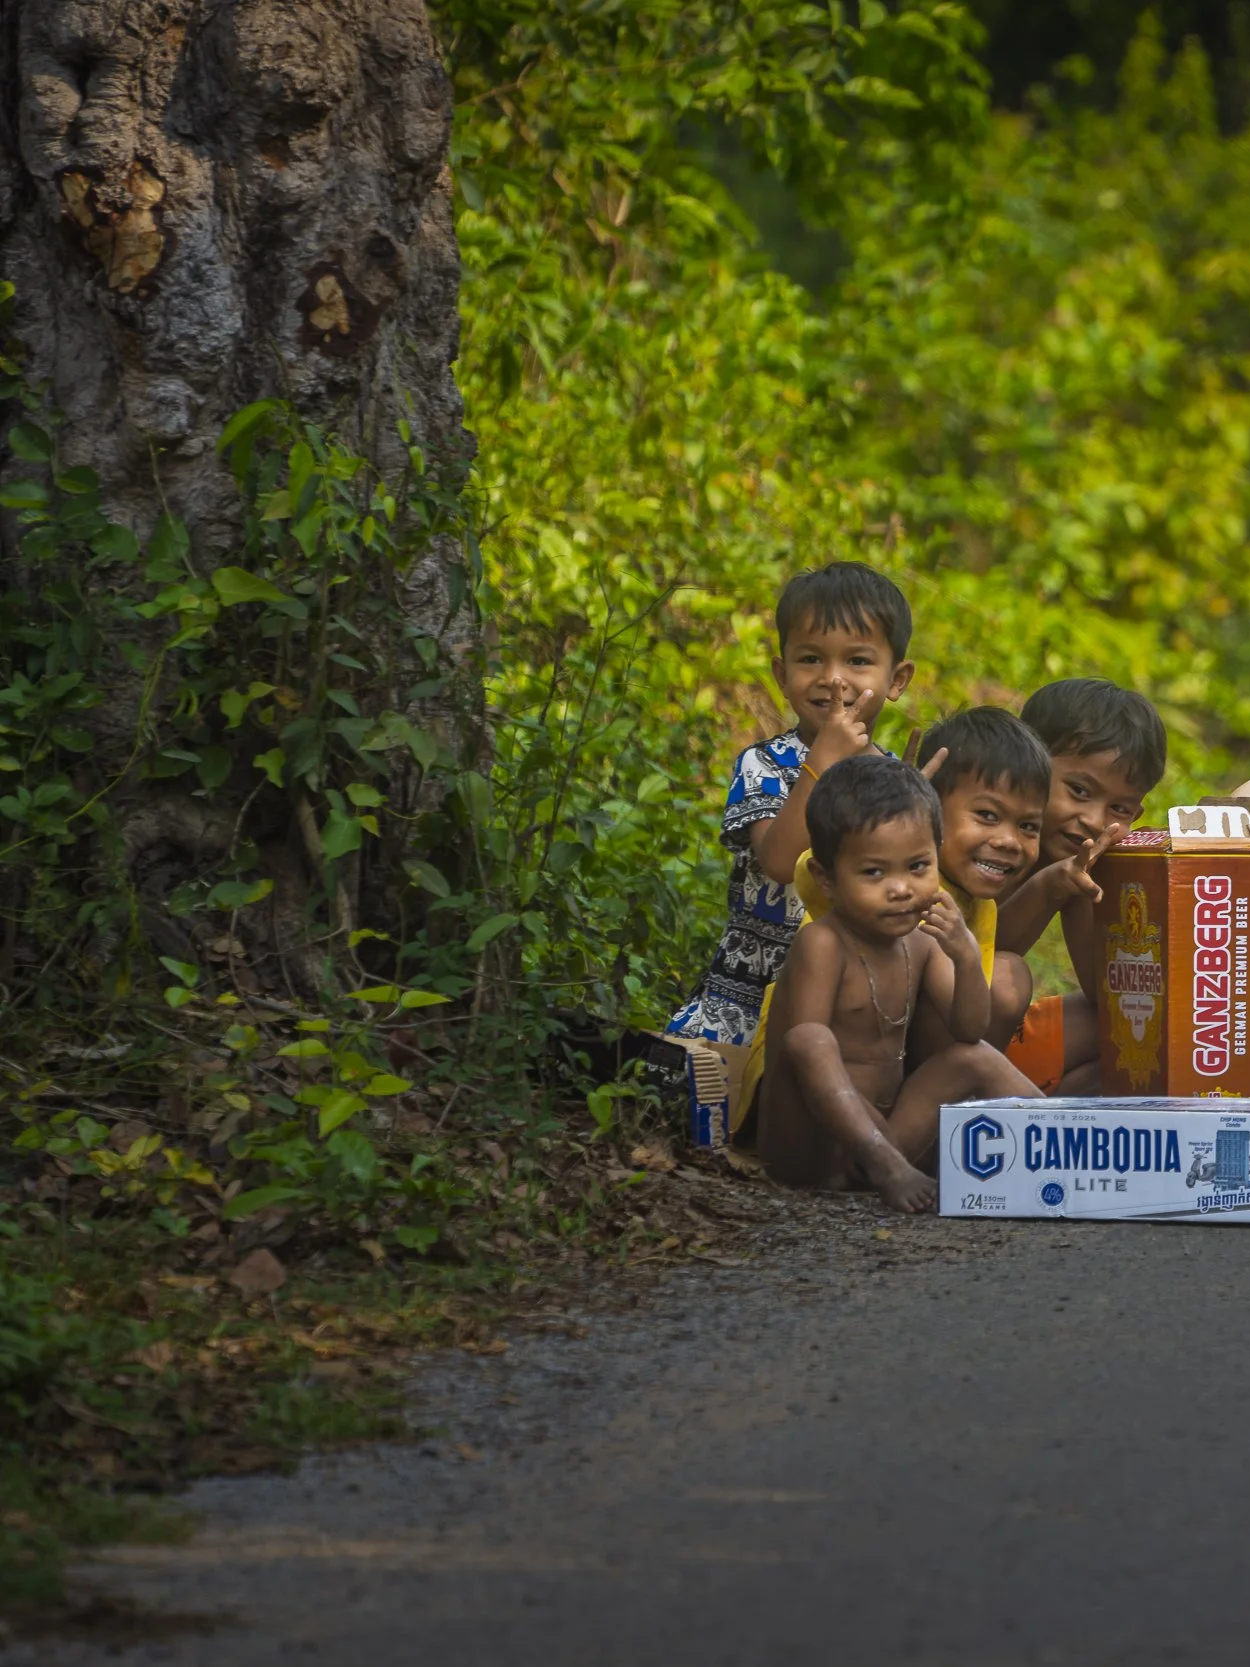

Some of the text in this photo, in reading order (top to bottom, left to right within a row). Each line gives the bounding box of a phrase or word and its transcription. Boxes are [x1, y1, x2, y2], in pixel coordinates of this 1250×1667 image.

[1107, 961, 1163, 995] GANZBERG
[1193, 875, 1231, 1077] GANZBERG
[1234, 896, 1249, 1055] GERMAN PREMIUM BEER
[1024, 1123, 1182, 1175] CAMBODIA
[1044, 1187, 1062, 1202] 4%
[1074, 1177, 1128, 1193] LITE
